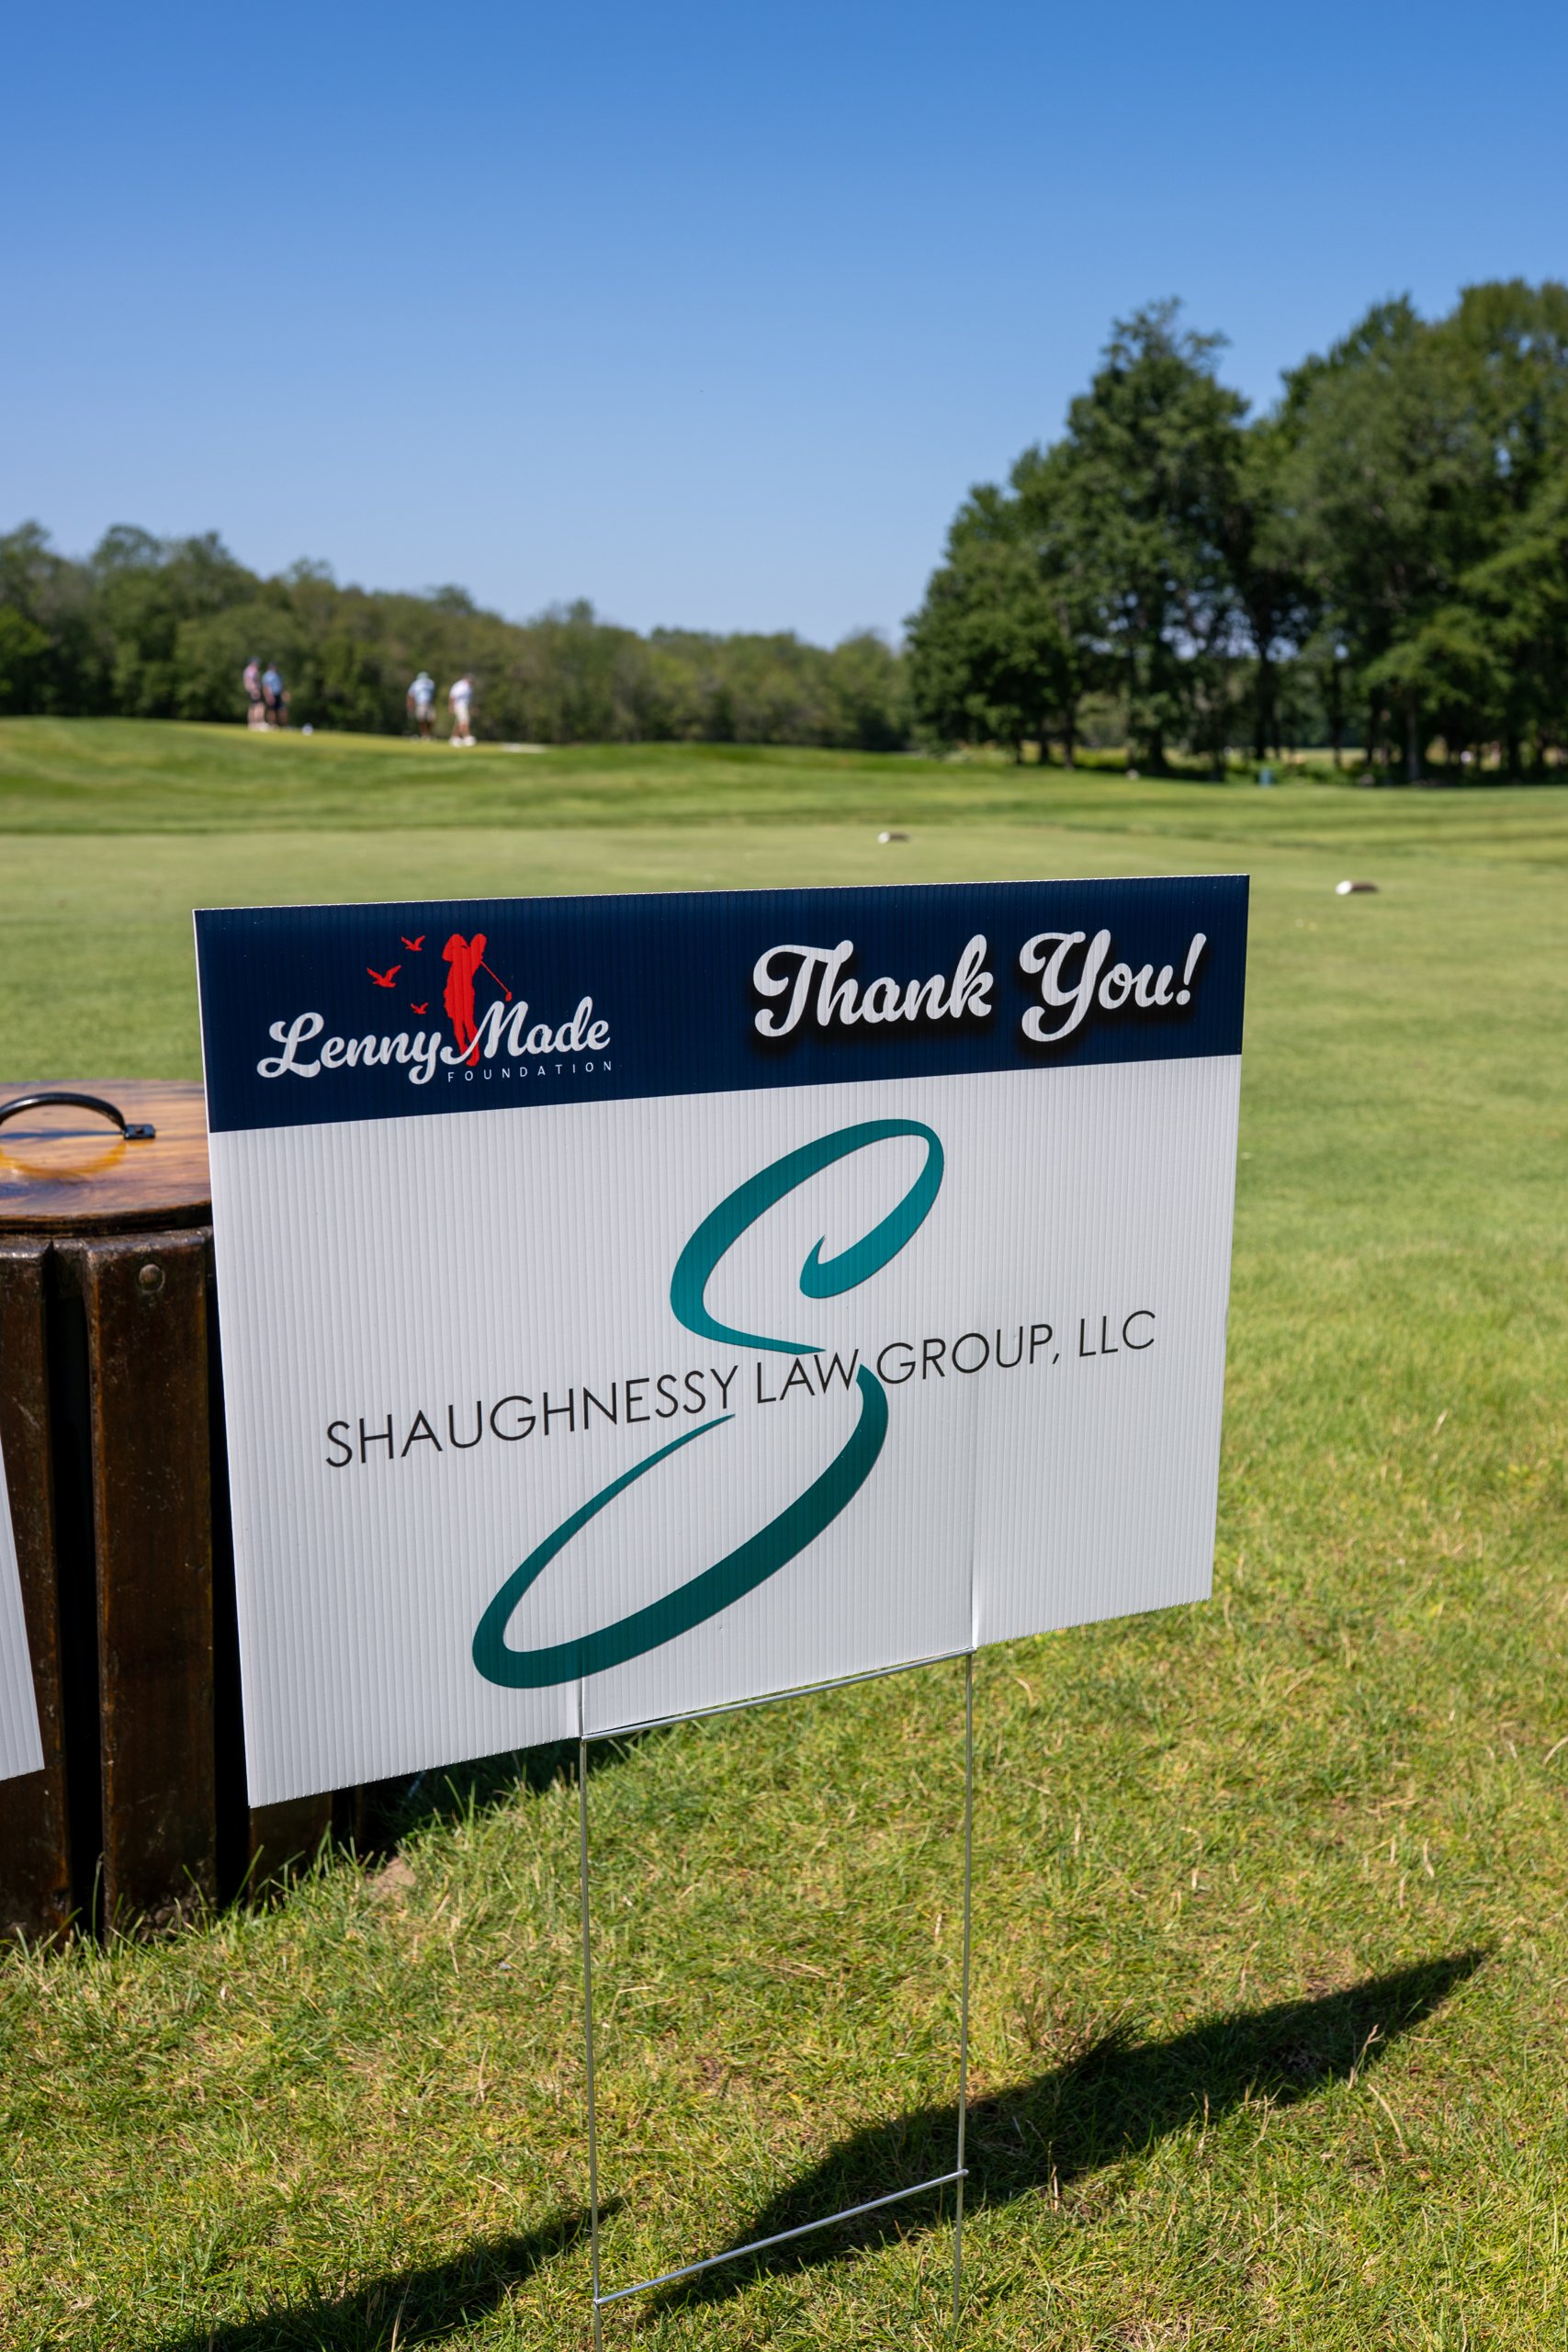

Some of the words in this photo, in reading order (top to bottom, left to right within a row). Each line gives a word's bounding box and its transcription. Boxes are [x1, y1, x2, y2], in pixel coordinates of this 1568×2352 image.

[752, 933, 994, 1037] Thank
[1019, 929, 1207, 1042] You!
[256, 1012, 443, 1085] Lenny
[440, 996, 611, 1065] Made
[447, 1059, 614, 1083] FOUNDATION
[326, 1365, 739, 1467] SHAUGHNESSY
[756, 1349, 860, 1404] LAW
[876, 1323, 1061, 1385] GROUP,
[1078, 1310, 1156, 1358] LLC
